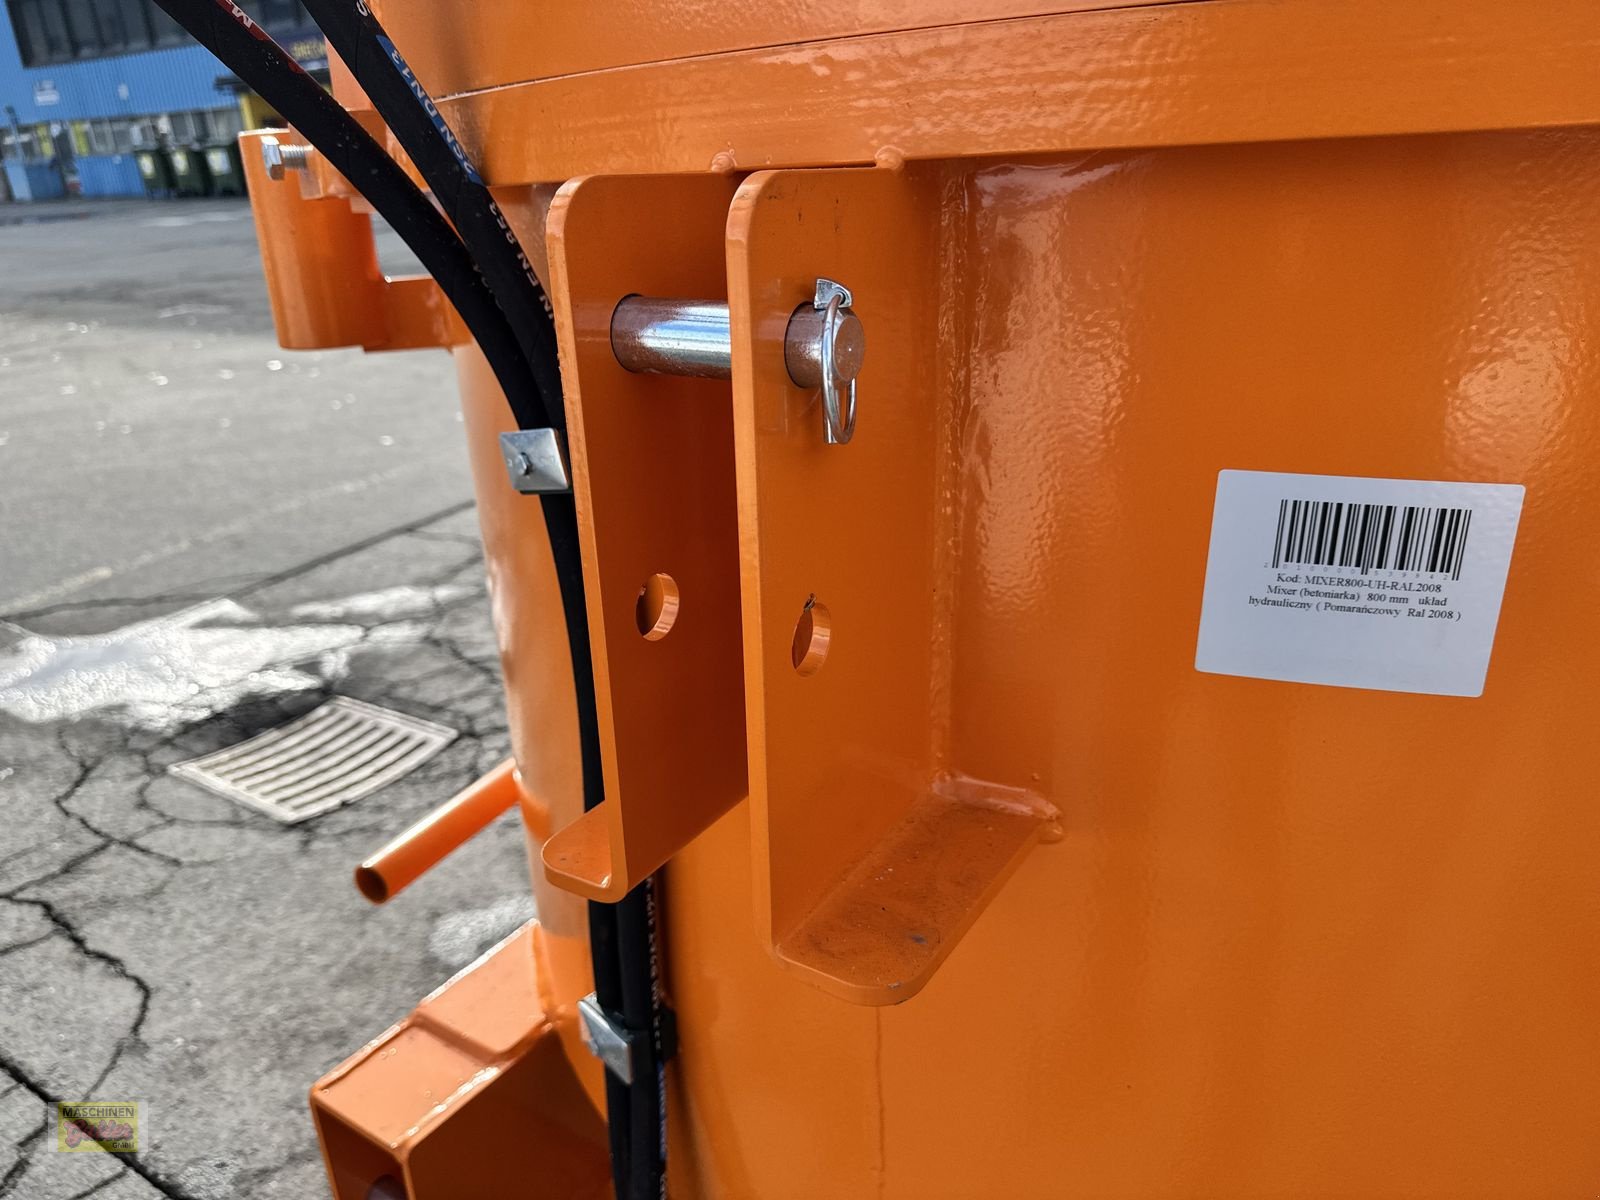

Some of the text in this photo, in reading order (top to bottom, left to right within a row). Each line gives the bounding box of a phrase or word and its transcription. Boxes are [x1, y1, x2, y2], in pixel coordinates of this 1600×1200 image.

[391, 48, 439, 118] DN13
[441, 125, 476, 175] 2SN
[1266, 585, 1298, 596] Mixer
[1300, 588, 1360, 602] (betoniarka)
[1367, 593, 1387, 602] 800
[1389, 595, 1409, 604] mm
[1277, 573, 1442, 593] Kod: MIXER800-UH-RAL2008
[1248, 595, 1313, 611] hydrauliczny
[1323, 602, 1401, 618] Pomarańczowy
[1407, 608, 1426, 618] Ral
[1427, 609, 1454, 619] 2008
